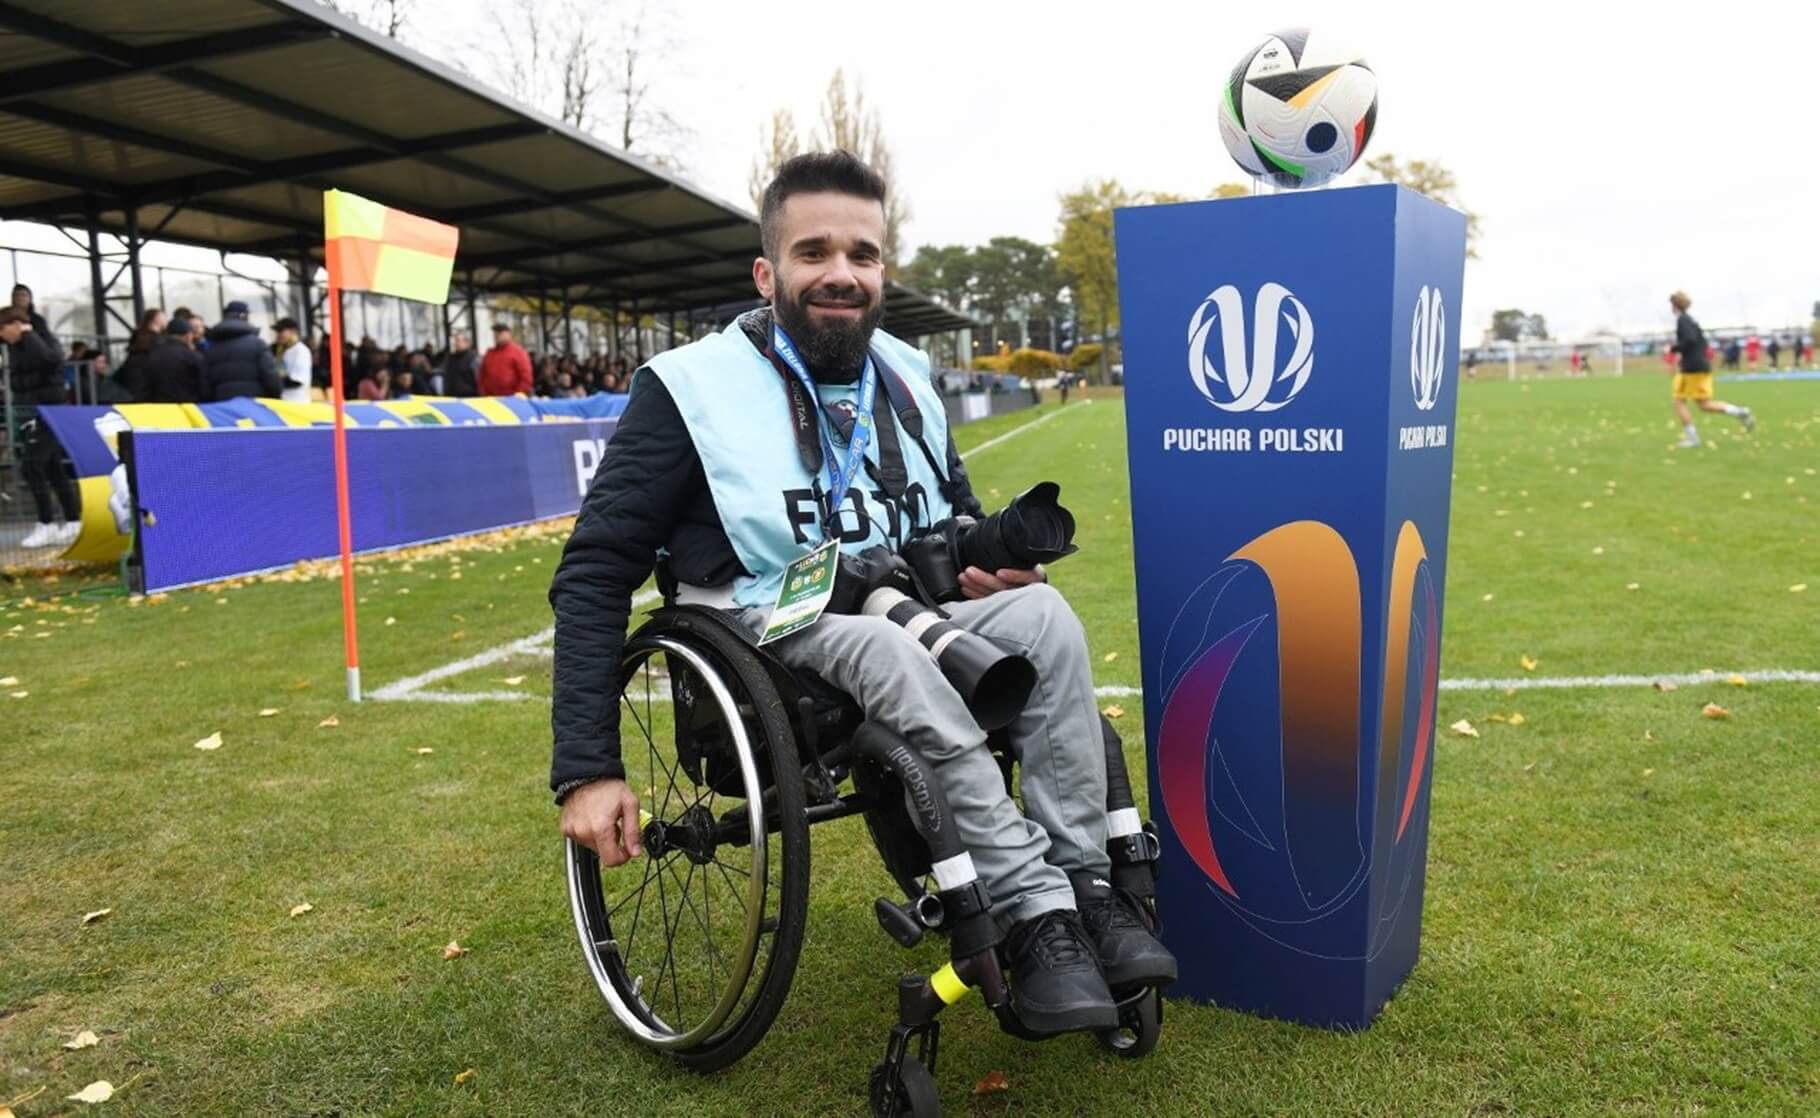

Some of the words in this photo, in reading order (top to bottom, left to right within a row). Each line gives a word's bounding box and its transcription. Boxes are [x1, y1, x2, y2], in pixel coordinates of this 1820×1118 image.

[1163, 428, 1251, 451] PUCHAR
[1259, 428, 1343, 451] POLSKI
[1399, 426, 1425, 450] PUCHAR
[1425, 424, 1447, 448] POLSKI
